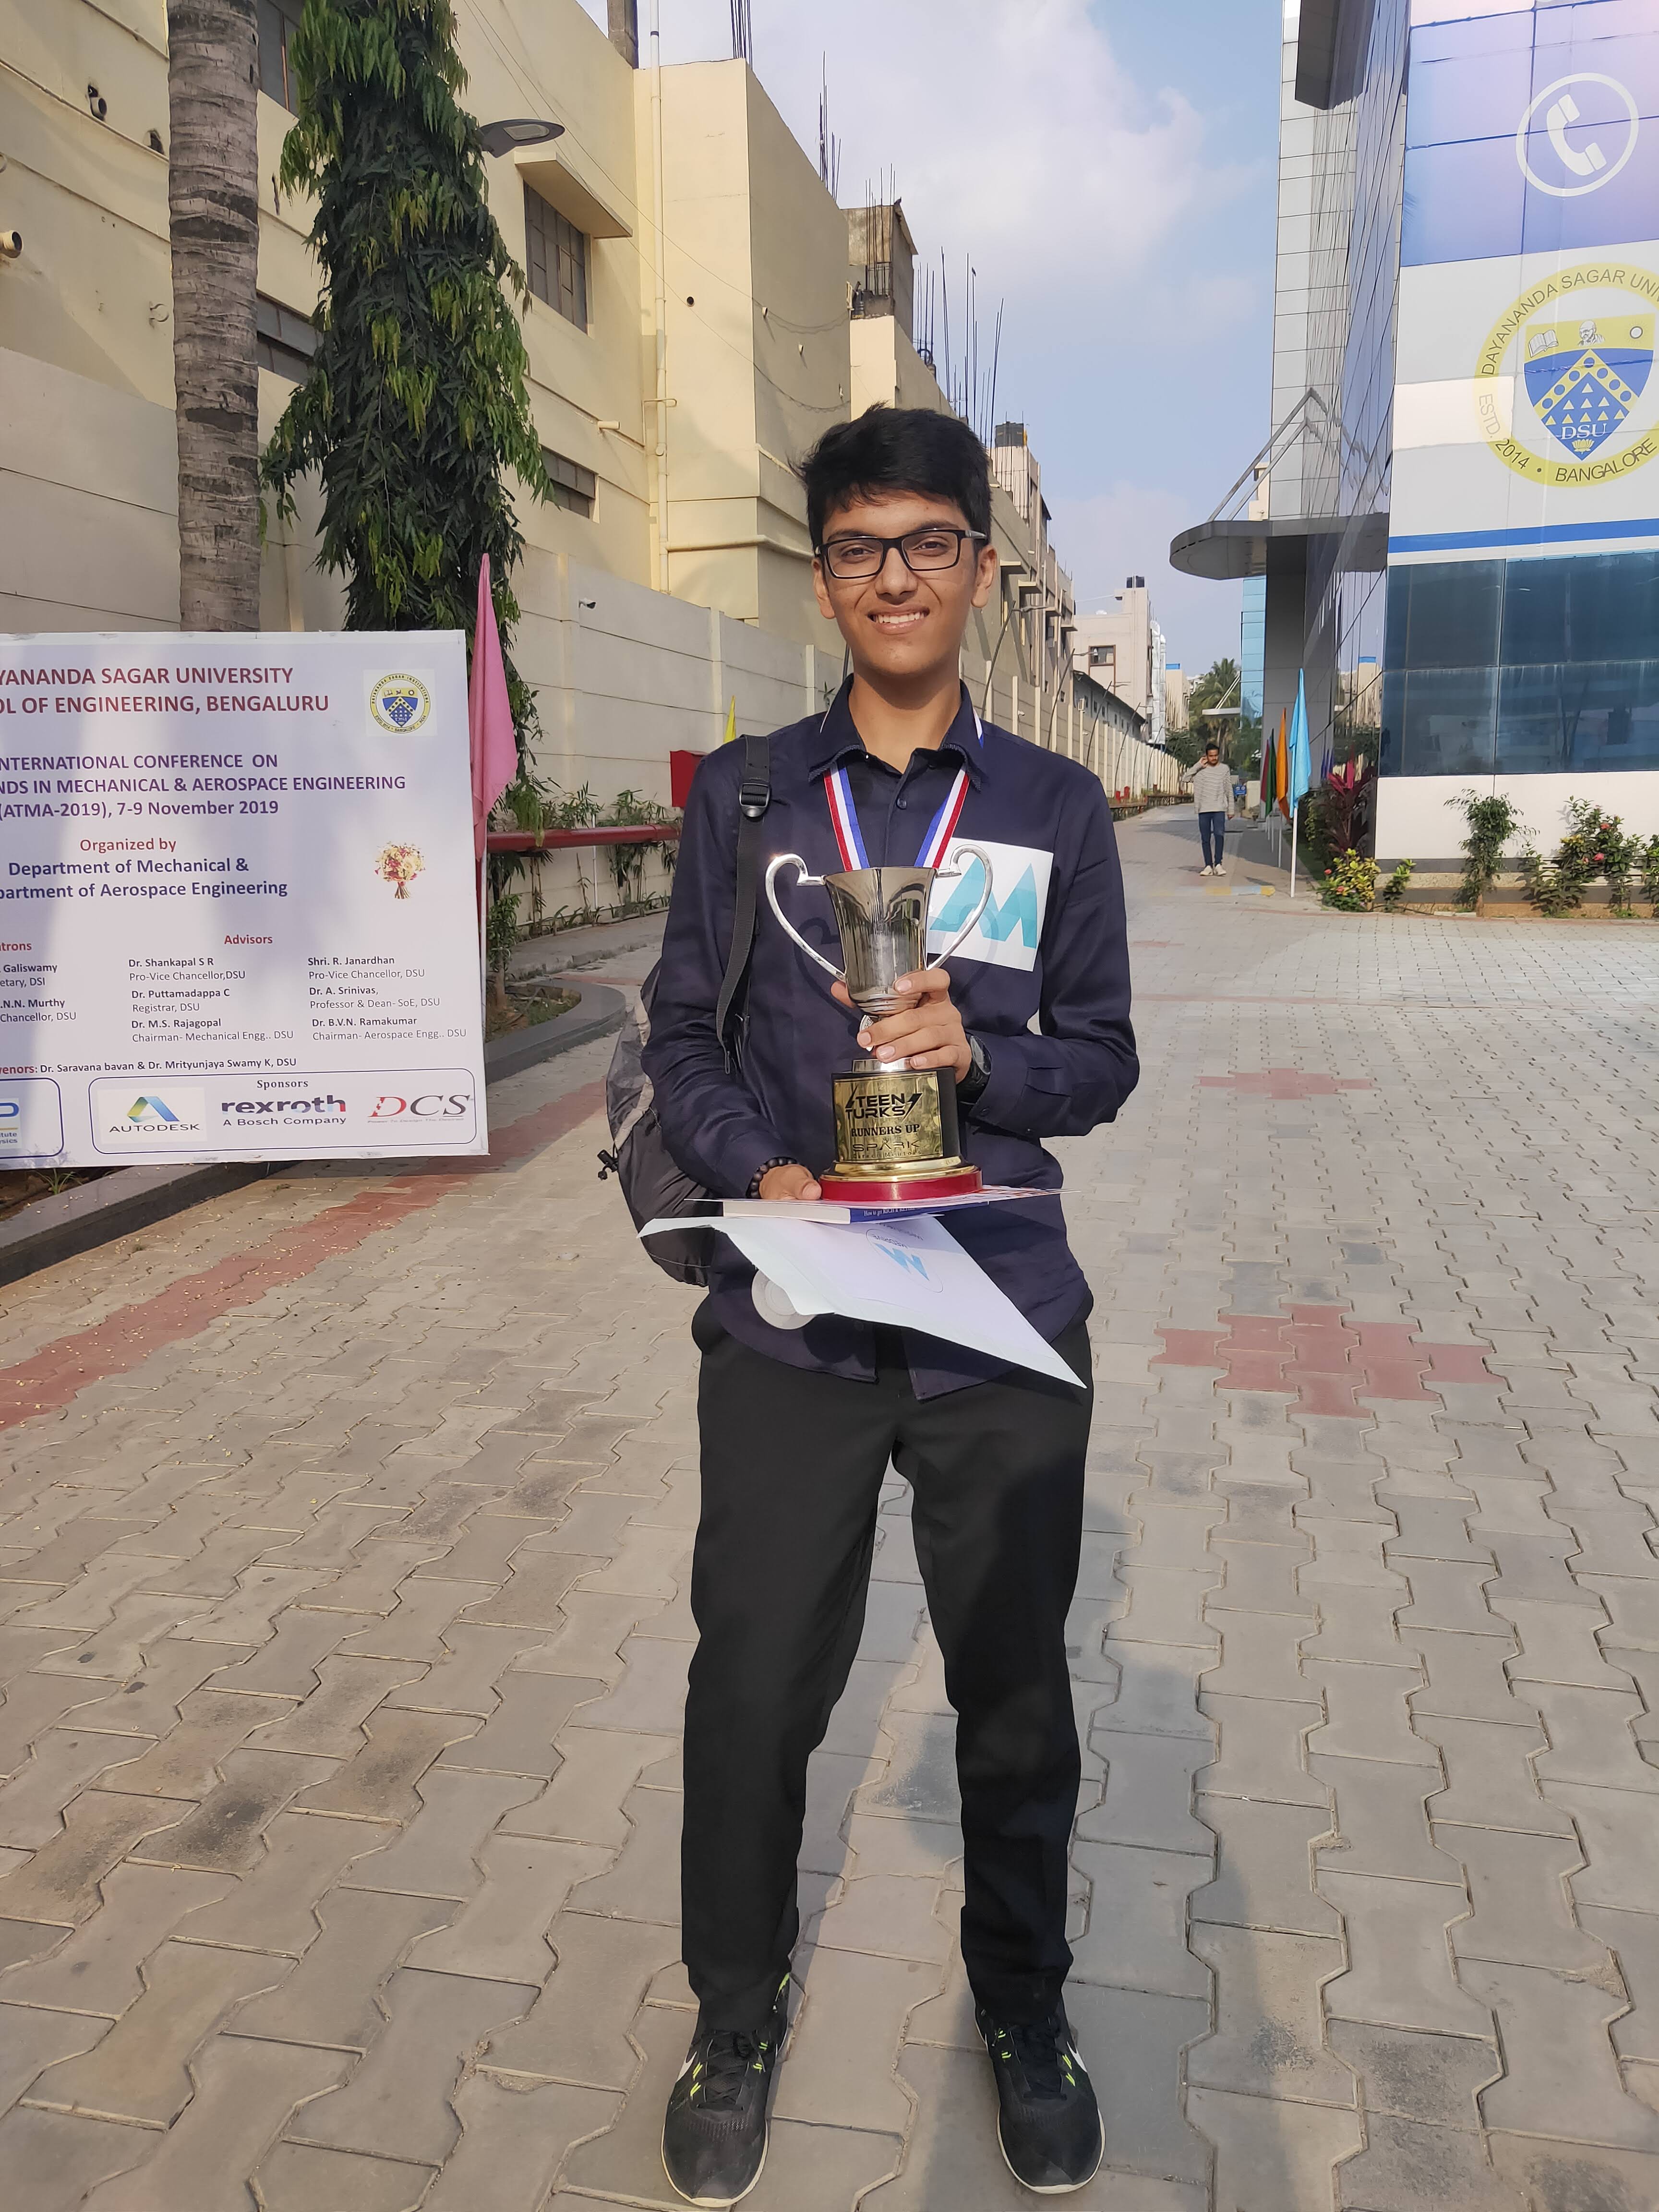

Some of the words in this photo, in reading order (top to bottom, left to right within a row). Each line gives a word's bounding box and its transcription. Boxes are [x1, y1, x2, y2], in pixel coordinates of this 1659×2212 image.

[1481, 284, 1559, 375] DAYANANDA
[1561, 269, 1625, 289] SAGAR
[1630, 274, 1659, 302] UNI
[1561, 423, 1607, 440] DSU
[1479, 394, 1501, 439] ESTD.
[1496, 438, 1530, 469] 2014
[1555, 438, 1657, 482] BANGALORE
[102, 668, 170, 684] SAGAR
[176, 668, 293, 684] UNIVERSITY
[22, 697, 48, 713] OF
[55, 696, 200, 715] ENGINEERING,
[207, 696, 328, 711] BENGALURU
[0, 756, 129, 770] NTERNATIONAL
[133, 755, 243, 769] CONFERENCE
[252, 755, 277, 768] ON
[34, 780, 50, 793] IN
[57, 779, 169, 793] MECHANICAL
[174, 778, 187, 792] &
[192, 778, 288, 791] AEROSPACE
[293, 776, 406, 791] ENGINEERING
[117, 802, 143, 816] 7-9
[148, 801, 234, 816] November
[240, 801, 278, 814] 2019
[80, 838, 155, 854] Organized
[159, 838, 177, 853] by
[9, 861, 110, 878] Department
[115, 859, 132, 873] of
[137, 858, 230, 873] Mechanical
[236, 858, 249, 872] &
[78, 884, 96, 897] of
[100, 883, 186, 899] Aerospace
[192, 881, 288, 898] Engineering
[224, 934, 273, 945] Advisors
[0, 942, 32, 951] trons
[129, 959, 142, 967] Dr.
[145, 958, 196, 968] Shankapal
[207, 958, 214, 966] R
[308, 957, 330, 966] Shri.
[333, 957, 342, 965] R.
[345, 956, 395, 965] Janardhan
[3, 964, 58, 973] Galiswamy
[309, 970, 349, 980] Pro-Vice
[351, 969, 403, 979] Chancellor,
[406, 969, 425, 977] DSU
[129, 971, 170, 981] Pro-Vice
[0, 979, 26, 988] etary,
[30, 977, 45, 986] DSI
[132, 990, 145, 998] Dr.
[148, 989, 221, 999] Puttamadappa
[224, 989, 230, 997] C
[309, 987, 323, 996] Dr.
[325, 987, 336, 995] A.
[338, 986, 379, 996] Srinivas,
[28, 998, 65, 1008] Murthy
[132, 1003, 177, 1014] Registrar,
[180, 1003, 200, 1011] DSU
[310, 1000, 354, 1009] Professor
[357, 999, 365, 1008] &
[368, 999, 396, 1008] Dean-
[398, 998, 418, 1008] SoE,
[421, 998, 440, 1006] DSU
[0, 1012, 54, 1022] Chancellor,
[57, 1012, 76, 1021] DSU
[312, 1019, 325, 1027] Dr.
[328, 1018, 357, 1026] B.V.N.
[360, 1017, 417, 1026] Ramakumar
[131, 1020, 145, 1028] Dr.
[148, 1020, 170, 1028] M.S.
[173, 1018, 221, 1029] Rajagopal
[132, 1034, 183, 1043] Chairman-
[185, 1032, 240, 1041] Mechanical
[274, 1031, 294, 1039] DSU
[313, 1032, 361, 1041] Chairman-
[364, 1031, 413, 1041] Aerospace
[447, 1029, 467, 1037] DSU
[0, 1066, 37, 1074] enors:
[40, 1065, 54, 1073] Dr.
[57, 1064, 101, 1072] Saravana
[105, 1062, 134, 1071] bavan
[137, 1061, 145, 1070] &
[148, 1061, 162, 1070] Dr.
[166, 1060, 224, 1070] Mrityunjaya
[227, 1058, 262, 1069] Swamy
[264, 1058, 274, 1068] K,
[276, 1058, 297, 1066] DSU
[257, 1079, 309, 1090] Sponsors
[221, 1094, 346, 1115] rexroth
[367, 1094, 470, 1118] DCS
[855, 1093, 905, 1107] TEEN
[845, 1106, 905, 1119] TURKS
[238, 1118, 278, 1126] Bosch
[283, 1117, 347, 1125] Company
[109, 1124, 200, 1133] AUTODESK
[852, 1125, 902, 1137] RUNNERS
[905, 1124, 920, 1133] UP
[853, 1140, 919, 1152] SPARK
